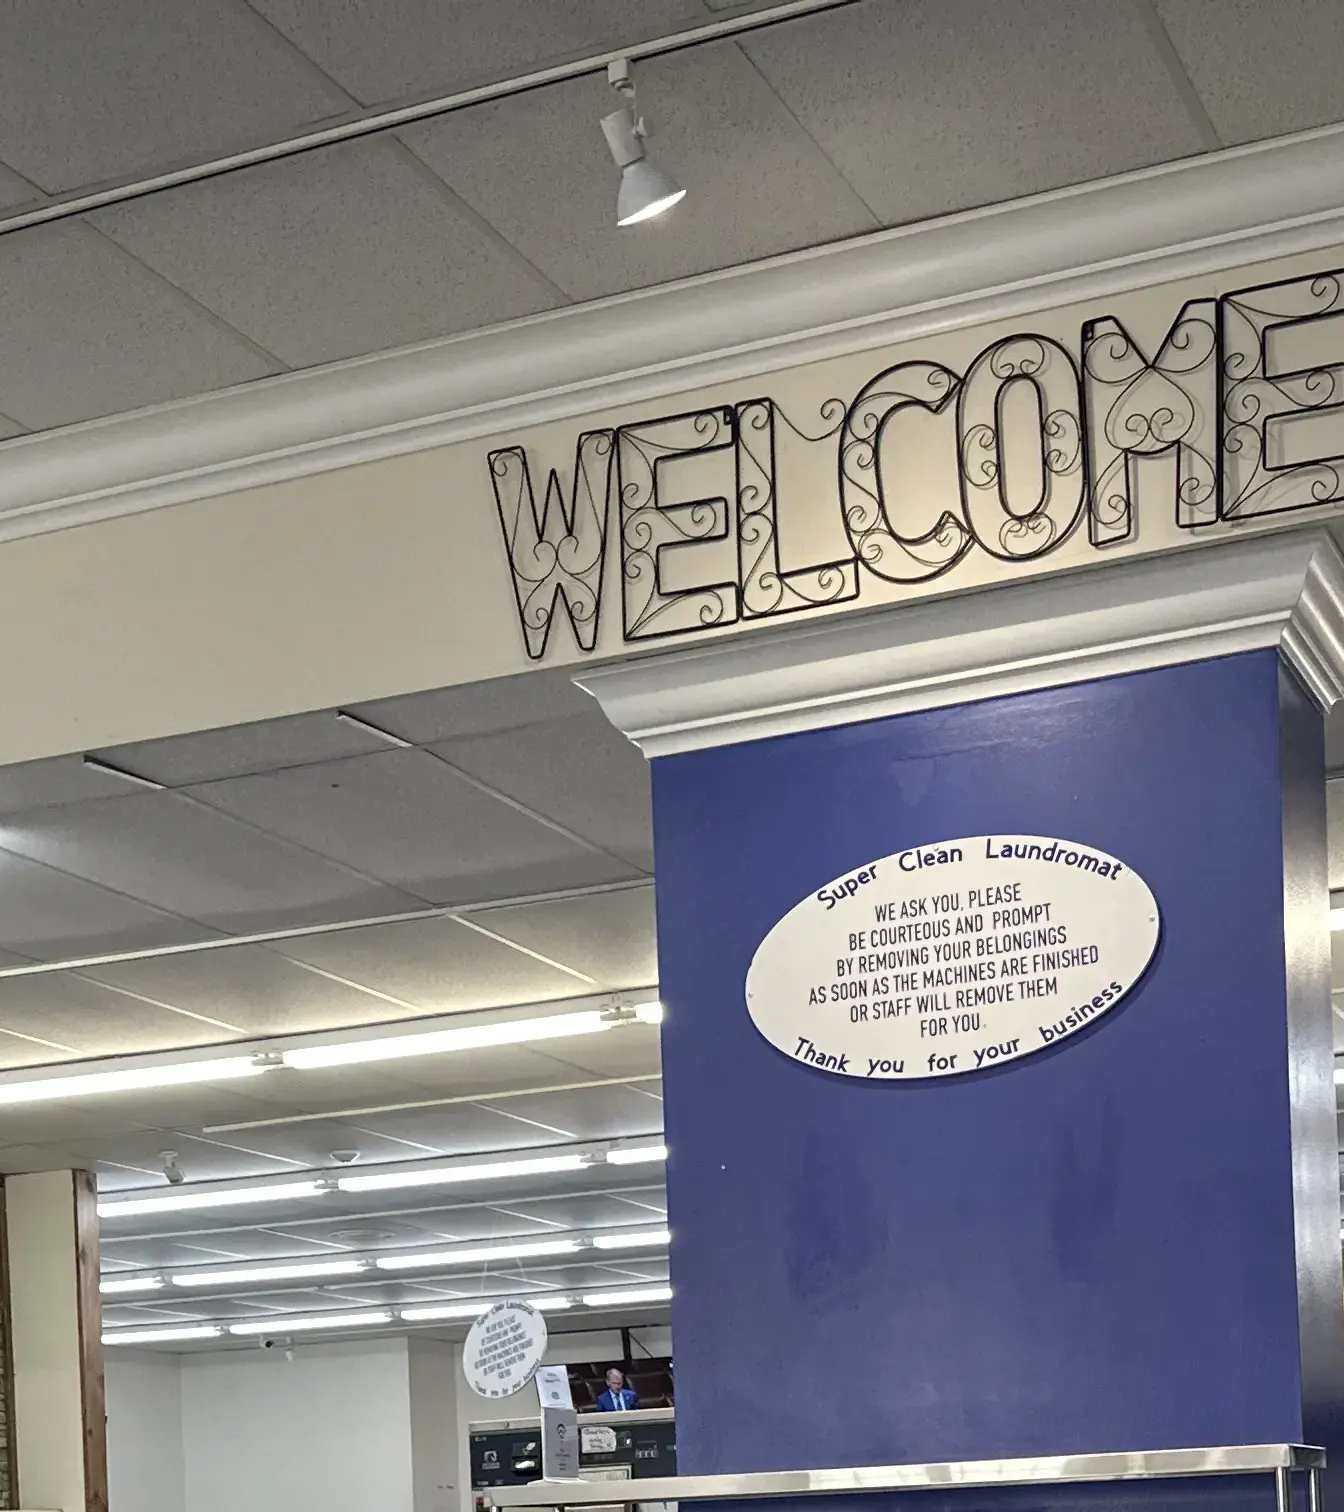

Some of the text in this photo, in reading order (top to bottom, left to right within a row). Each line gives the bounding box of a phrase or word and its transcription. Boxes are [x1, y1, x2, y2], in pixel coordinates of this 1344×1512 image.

[817, 838, 1123, 909] Super Clean Laundromat
[875, 904, 896, 922] WE
[900, 898, 928, 918] ASK
[968, 883, 1021, 908] PLEASE
[836, 926, 1067, 977] BY REMOVING YOUR BELONGINGS
[849, 904, 1052, 951] BE COURTEOUS AND PROMPT
[809, 945, 1099, 1006] AS SOON AS THE MACHINES ARE FINISHED
[850, 977, 1058, 1023] OR STAFF WILL REMOVE THEM
[793, 980, 1123, 1076] Thank you for your business
[920, 1020, 947, 1038] FOR
